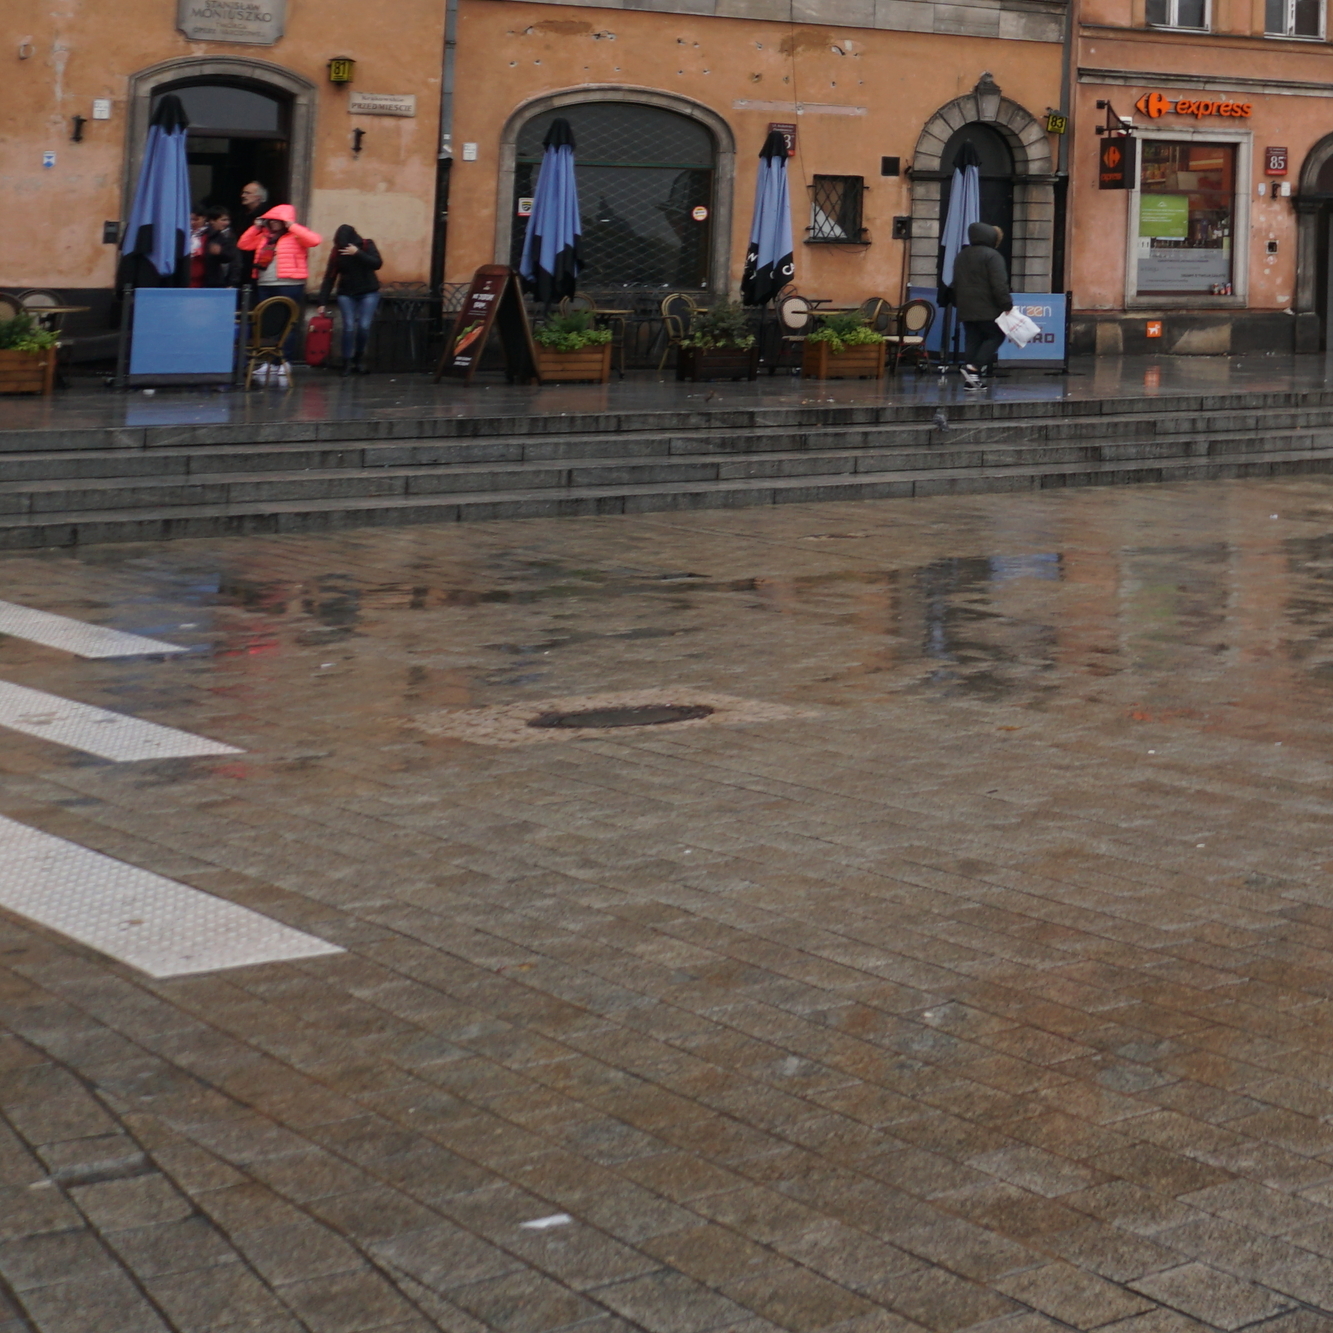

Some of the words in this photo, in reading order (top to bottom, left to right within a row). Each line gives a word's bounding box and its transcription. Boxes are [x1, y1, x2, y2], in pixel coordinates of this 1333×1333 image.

[191, 8, 272, 22] MONIUSZKO
[333, 61, 347, 75] 81
[1175, 97, 1253, 119] express
[1050, 115, 1064, 128] 83
[1270, 155, 1285, 170] 85
[1018, 305, 1052, 317] reen
